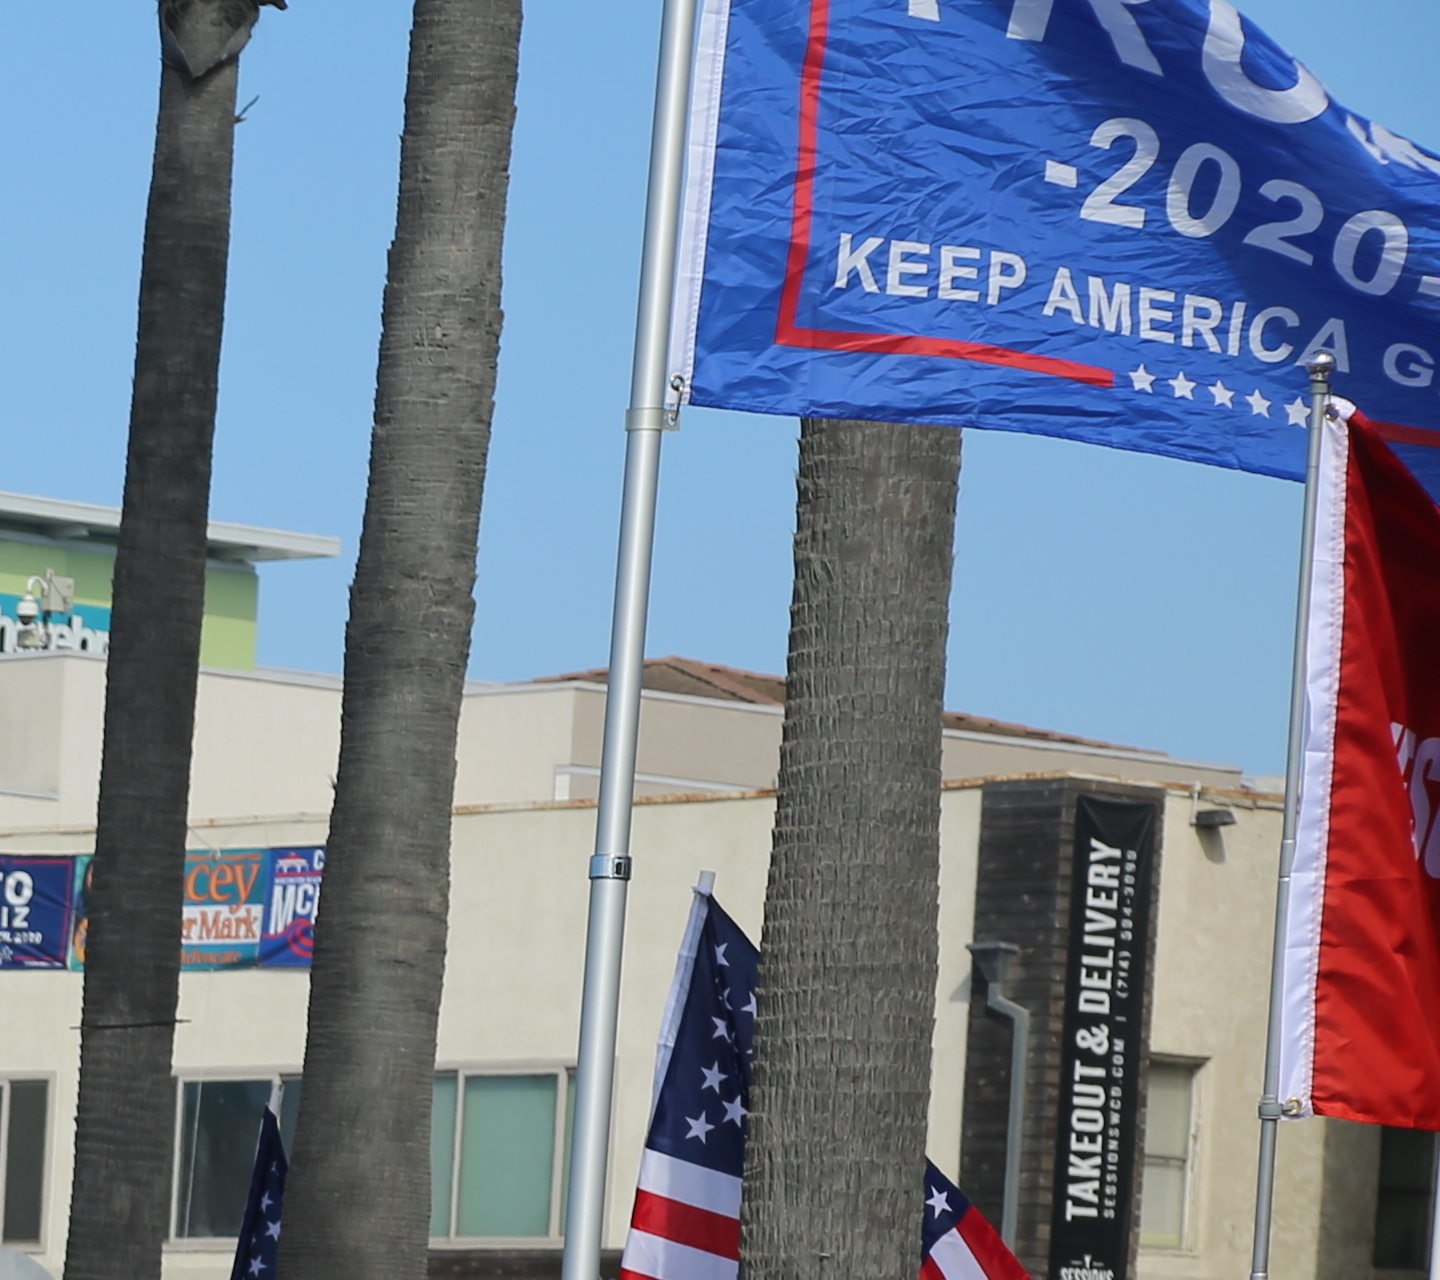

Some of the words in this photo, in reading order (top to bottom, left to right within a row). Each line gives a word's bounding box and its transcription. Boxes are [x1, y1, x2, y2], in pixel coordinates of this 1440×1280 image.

[833, 231, 1028, 306] KEEP
[1042, 266, 1352, 374] AMERICA
[186, 862, 261, 914] cey
[199, 908, 260, 941] Mark
[1078, 837, 1123, 1015] DELIVERY
[1074, 1022, 1111, 1057] &
[1065, 1060, 1108, 1223] TAKEOUT
